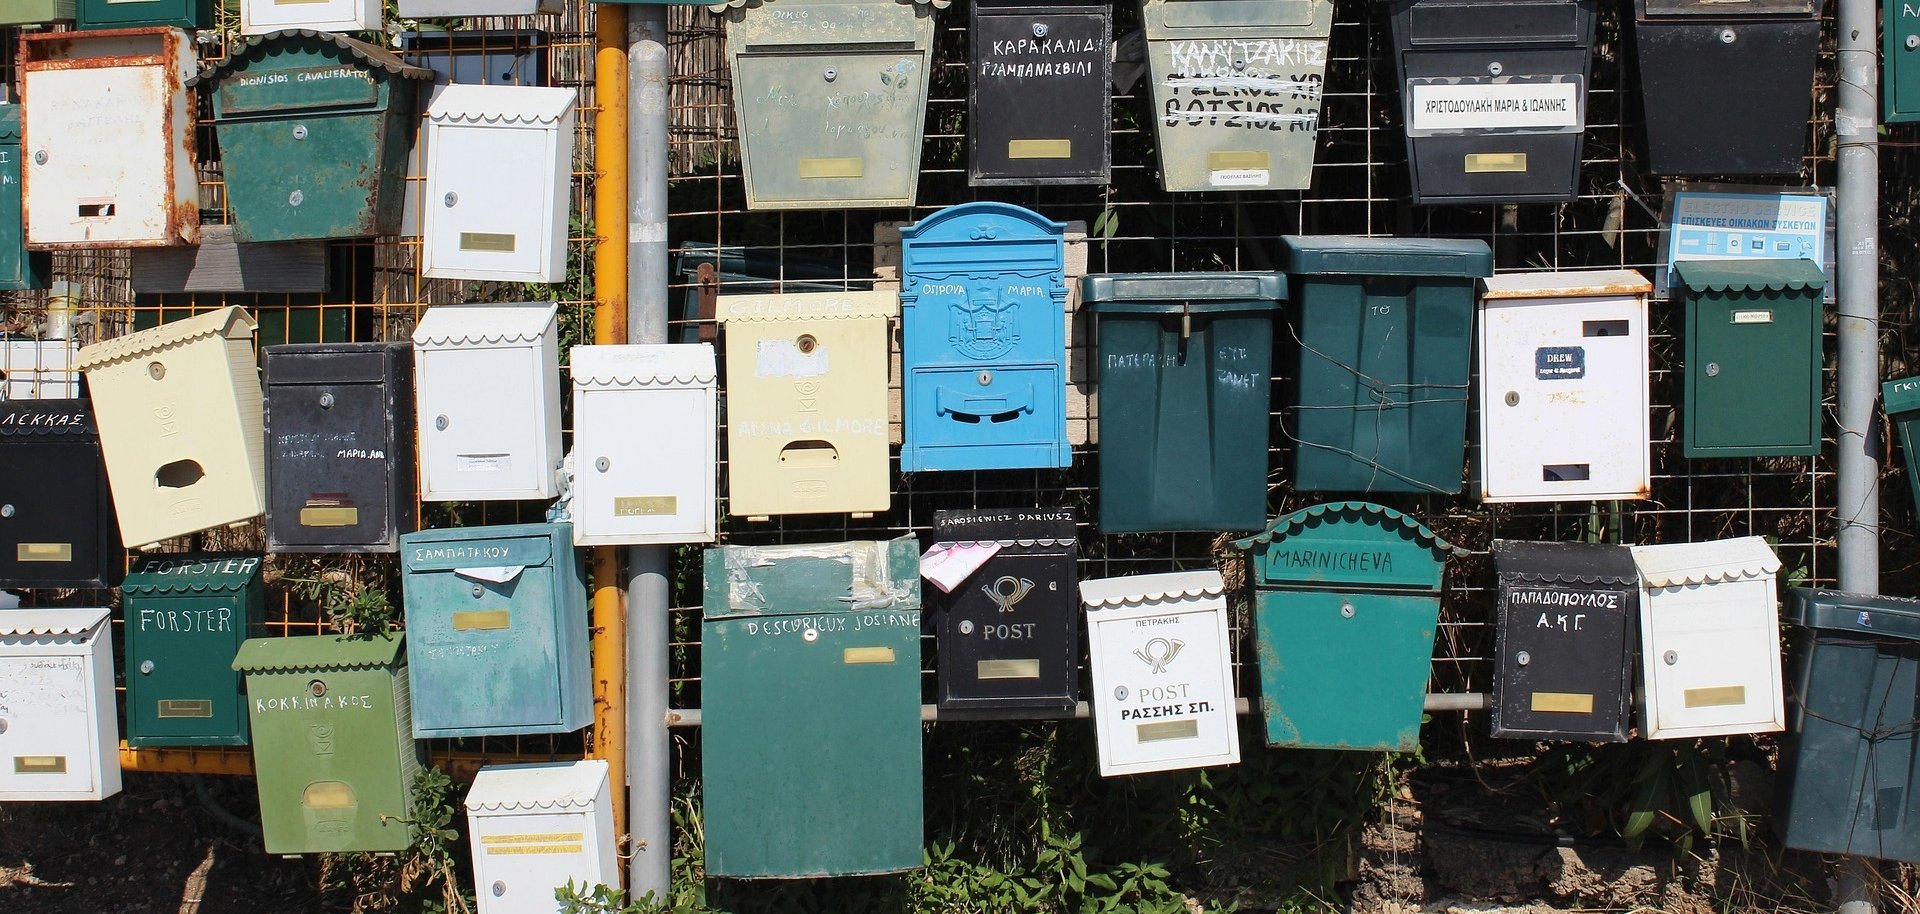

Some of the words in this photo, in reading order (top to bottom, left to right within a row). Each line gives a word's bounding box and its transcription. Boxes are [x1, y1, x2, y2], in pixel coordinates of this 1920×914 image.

[1902, 3, 1920, 17] Α
[1425, 98, 1492, 113] ΧΡΙΣΤΟΔΟΥΛΑΚΗ
[1494, 99, 1520, 112] ΜΑΡΙΑ
[1522, 99, 1528, 112] &
[1530, 98, 1566, 112] ΙΩΑΝΝΗΣ
[1680, 216, 1726, 226] ΕΠΙΣΚΕΥΕΣ
[1729, 218, 1773, 229] ΟΙΚΙΑΚΩΝ
[1773, 219, 1816, 230] ΣΥΣΚΕΥΩΝ
[1546, 353, 1573, 363] DREW
[1894, 381, 1920, 393] ΓΚΙ
[1018, 512, 1073, 522] DARIUSZ
[415, 547, 509, 561] ΣΑΜΠΑΤΑΚΟΥ
[1273, 550, 1393, 573] MARINICHEVA
[140, 557, 260, 575] FORSTER
[1511, 591, 1618, 609] ΠΑΠΑΔΟΠΟΥΛΟΣ
[140, 607, 231, 632] FORSTER
[854, 613, 921, 631] JOSIANE
[1136, 616, 1180, 628] ΠΕΤΡΑΚΗΣ
[983, 623, 1036, 640] POST
[1138, 683, 1190, 703] POST
[1121, 704, 1183, 720] ΡΑΣΣΗΣ
[1189, 701, 1215, 715] ΣΠ.
